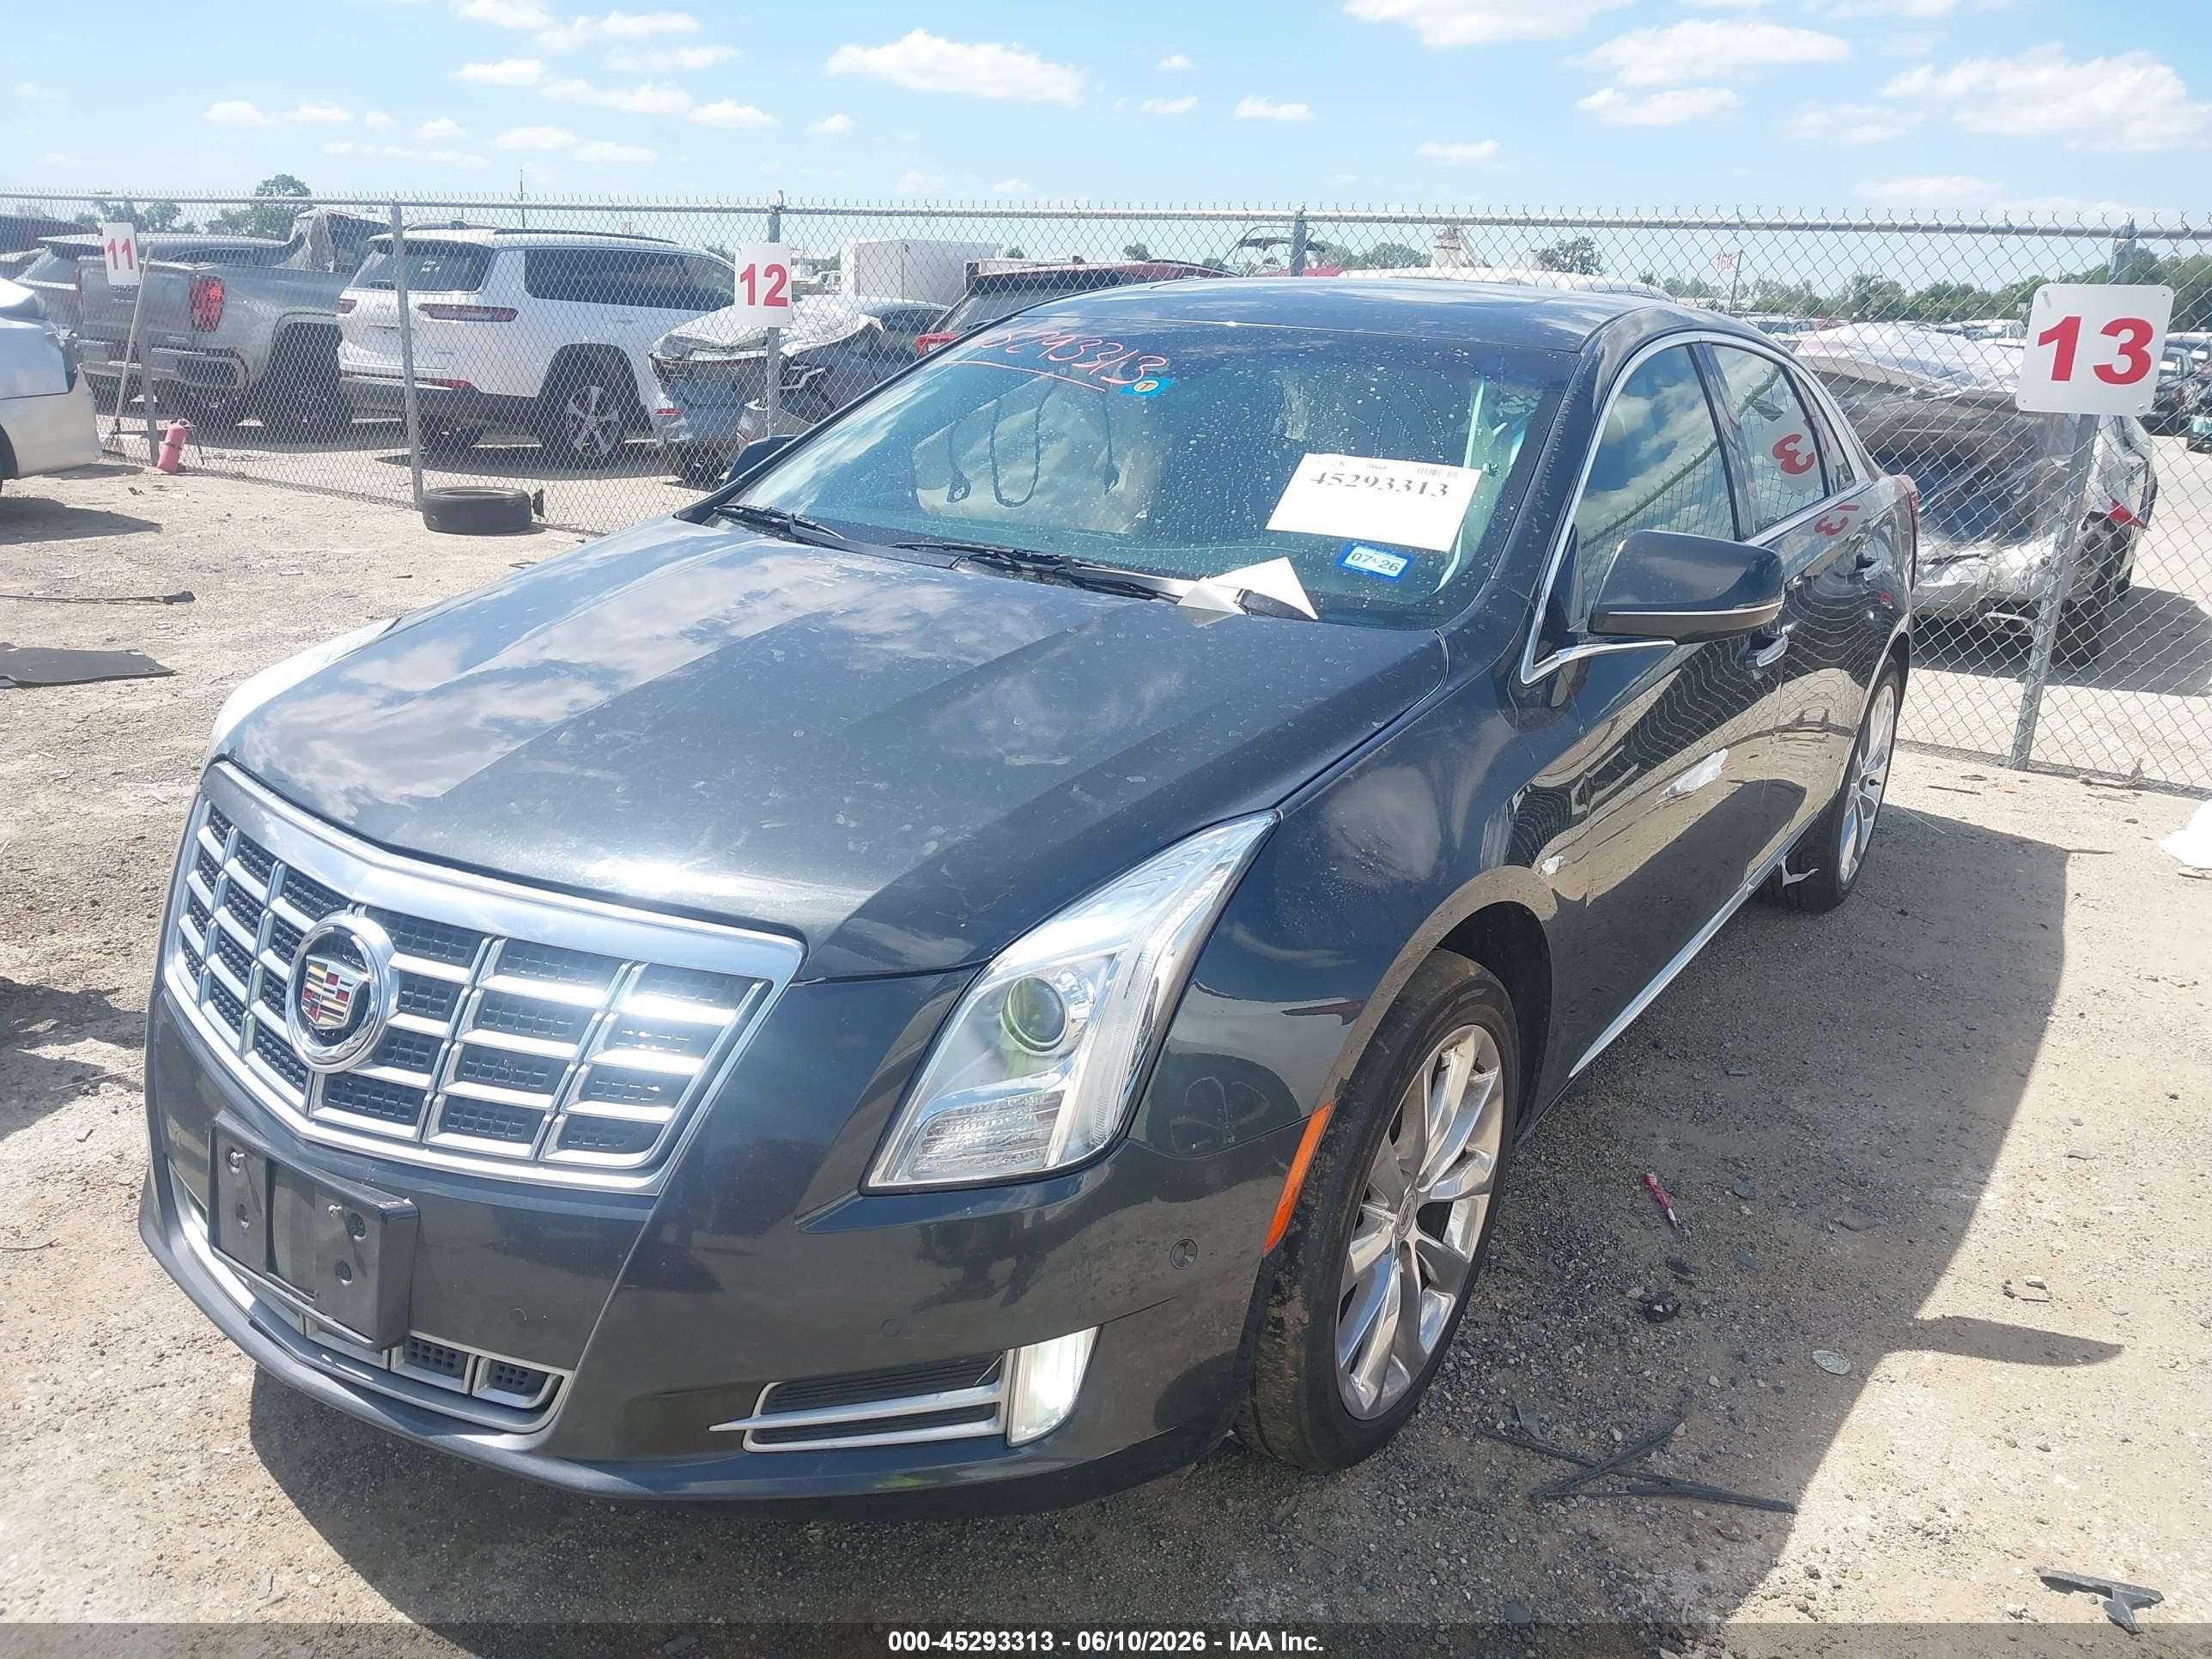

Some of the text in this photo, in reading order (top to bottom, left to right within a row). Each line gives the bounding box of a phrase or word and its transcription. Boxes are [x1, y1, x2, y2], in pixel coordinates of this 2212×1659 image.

[107, 238, 133, 270] 11
[739, 263, 788, 307] 12
[2038, 315, 2154, 385] 13
[1310, 471, 1449, 497] 45293313
